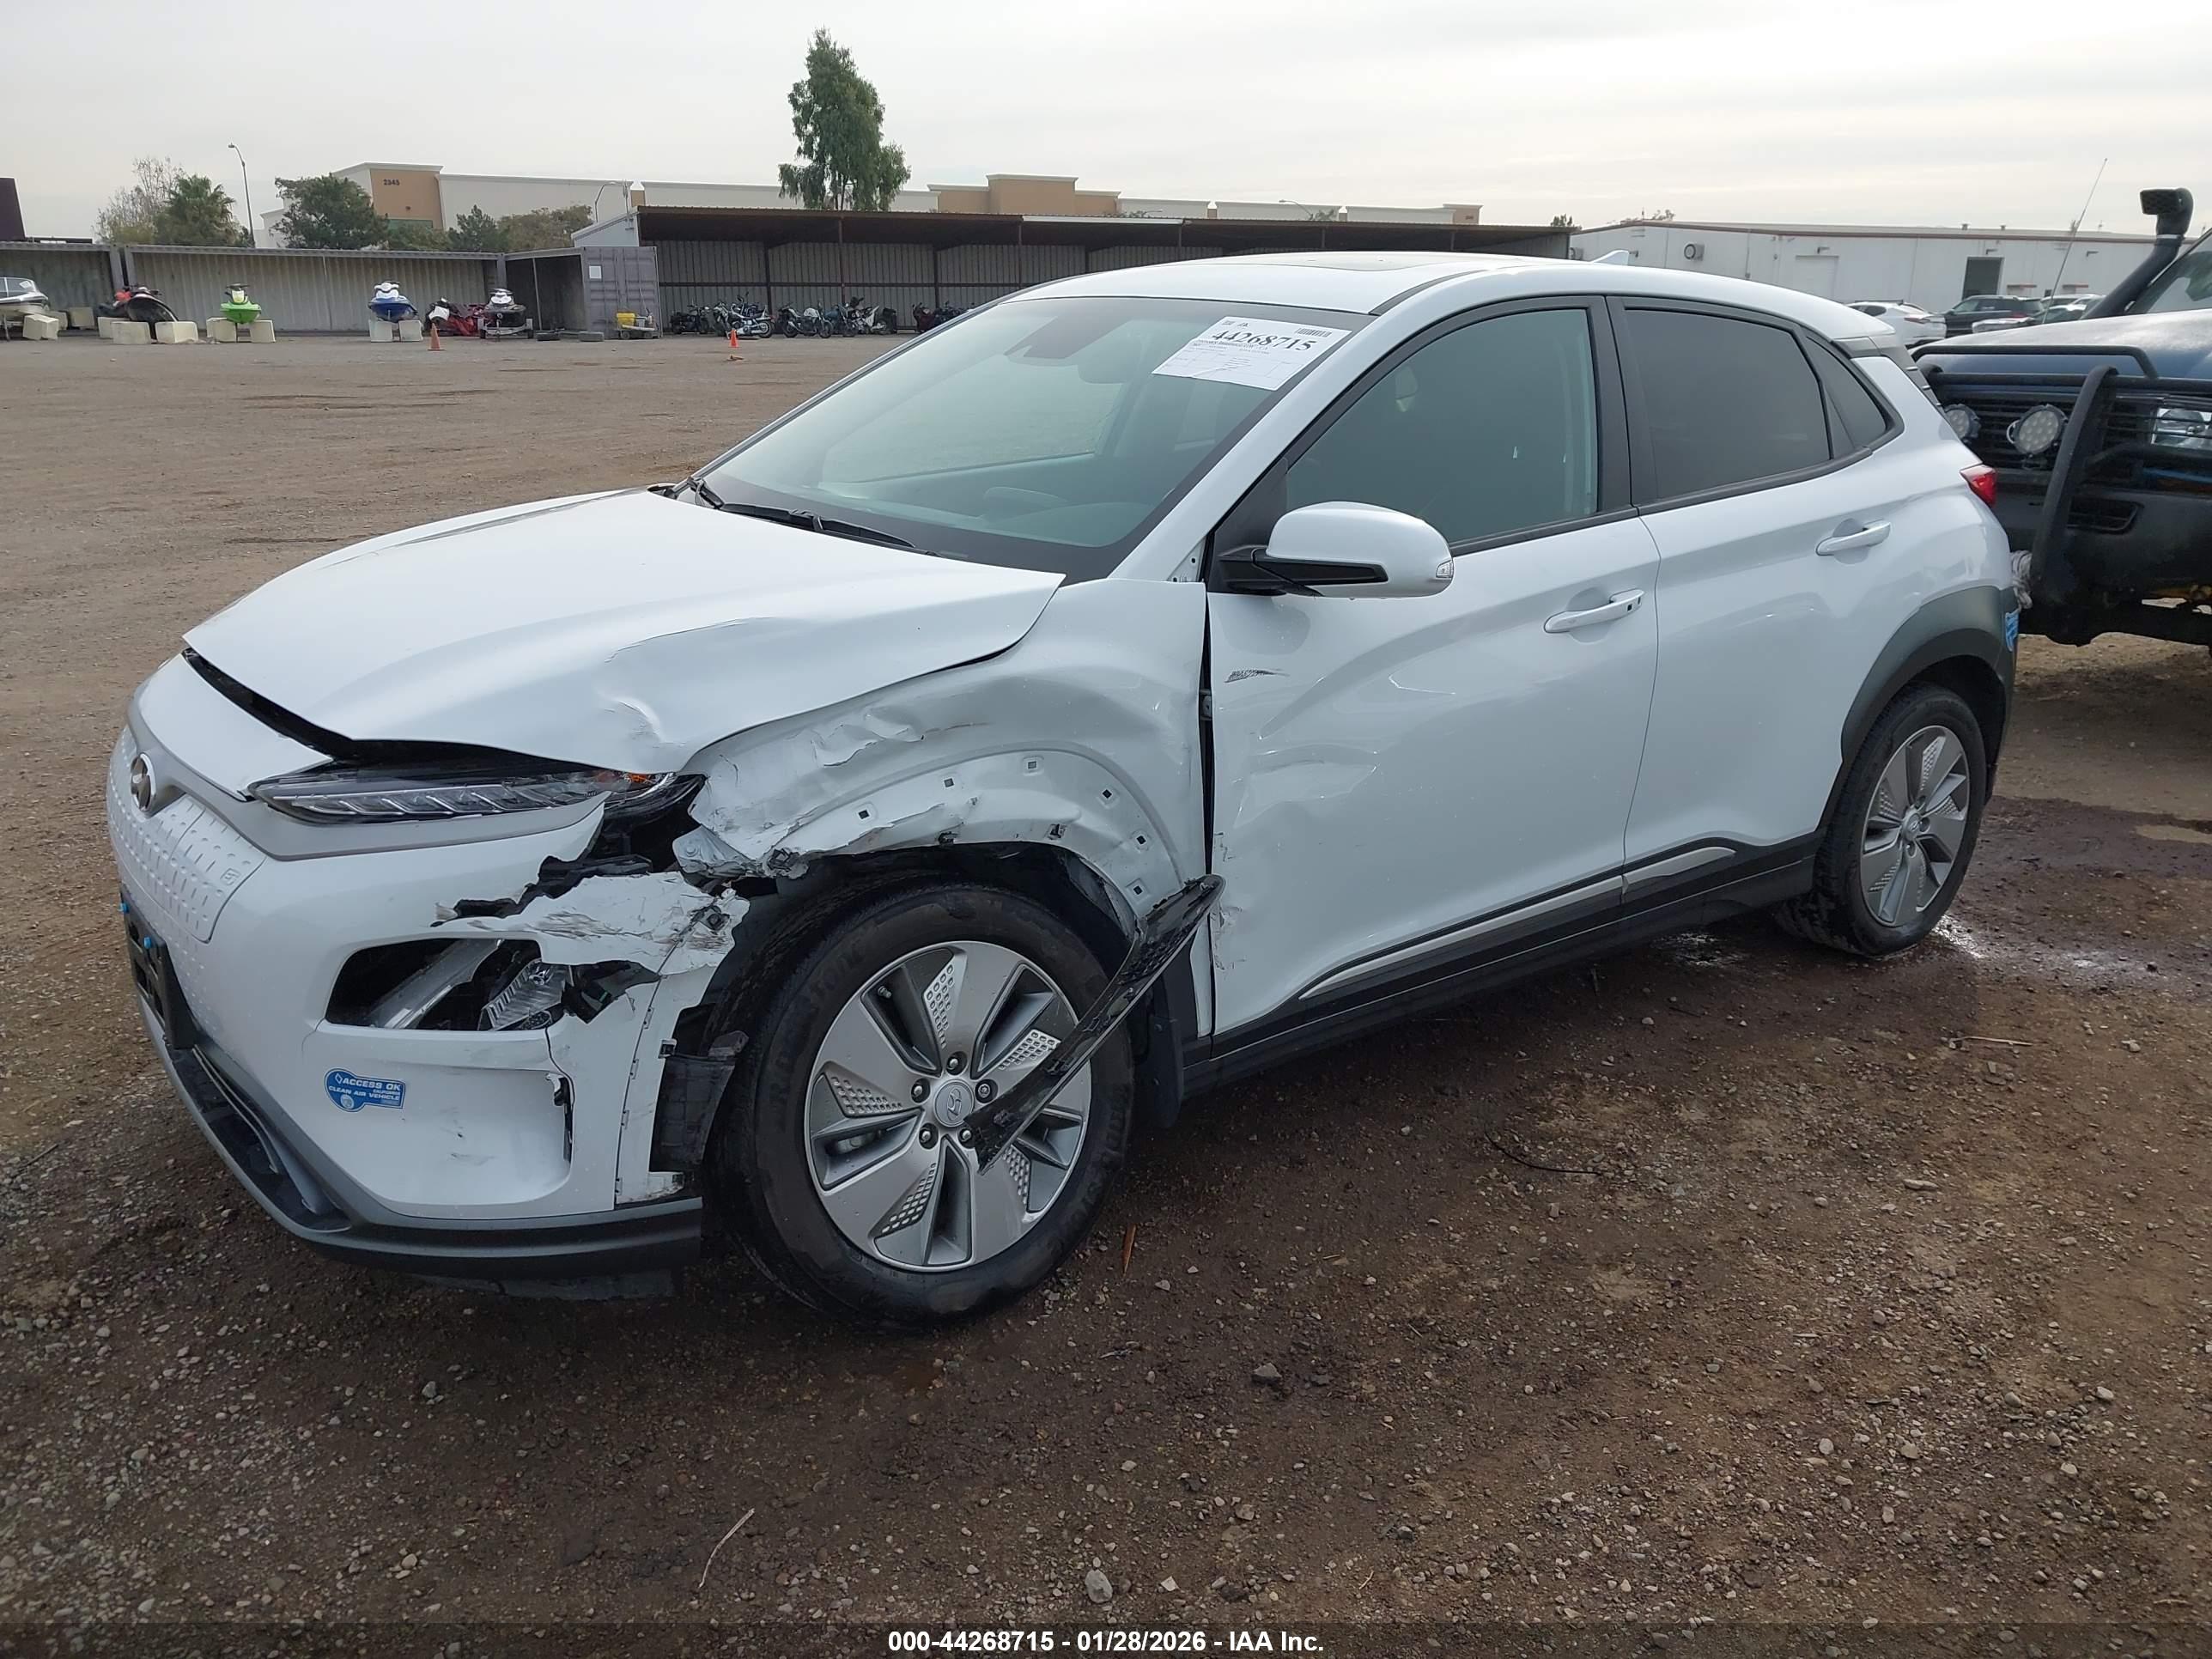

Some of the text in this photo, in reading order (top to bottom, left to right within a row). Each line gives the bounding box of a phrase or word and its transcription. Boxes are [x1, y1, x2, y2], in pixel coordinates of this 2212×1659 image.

[1212, 330, 1317, 351] 44268715
[342, 1078, 402, 1091] ACCESS OK
[328, 1085, 352, 1095] CLEAN
[368, 1092, 400, 1101] VEHICLE
